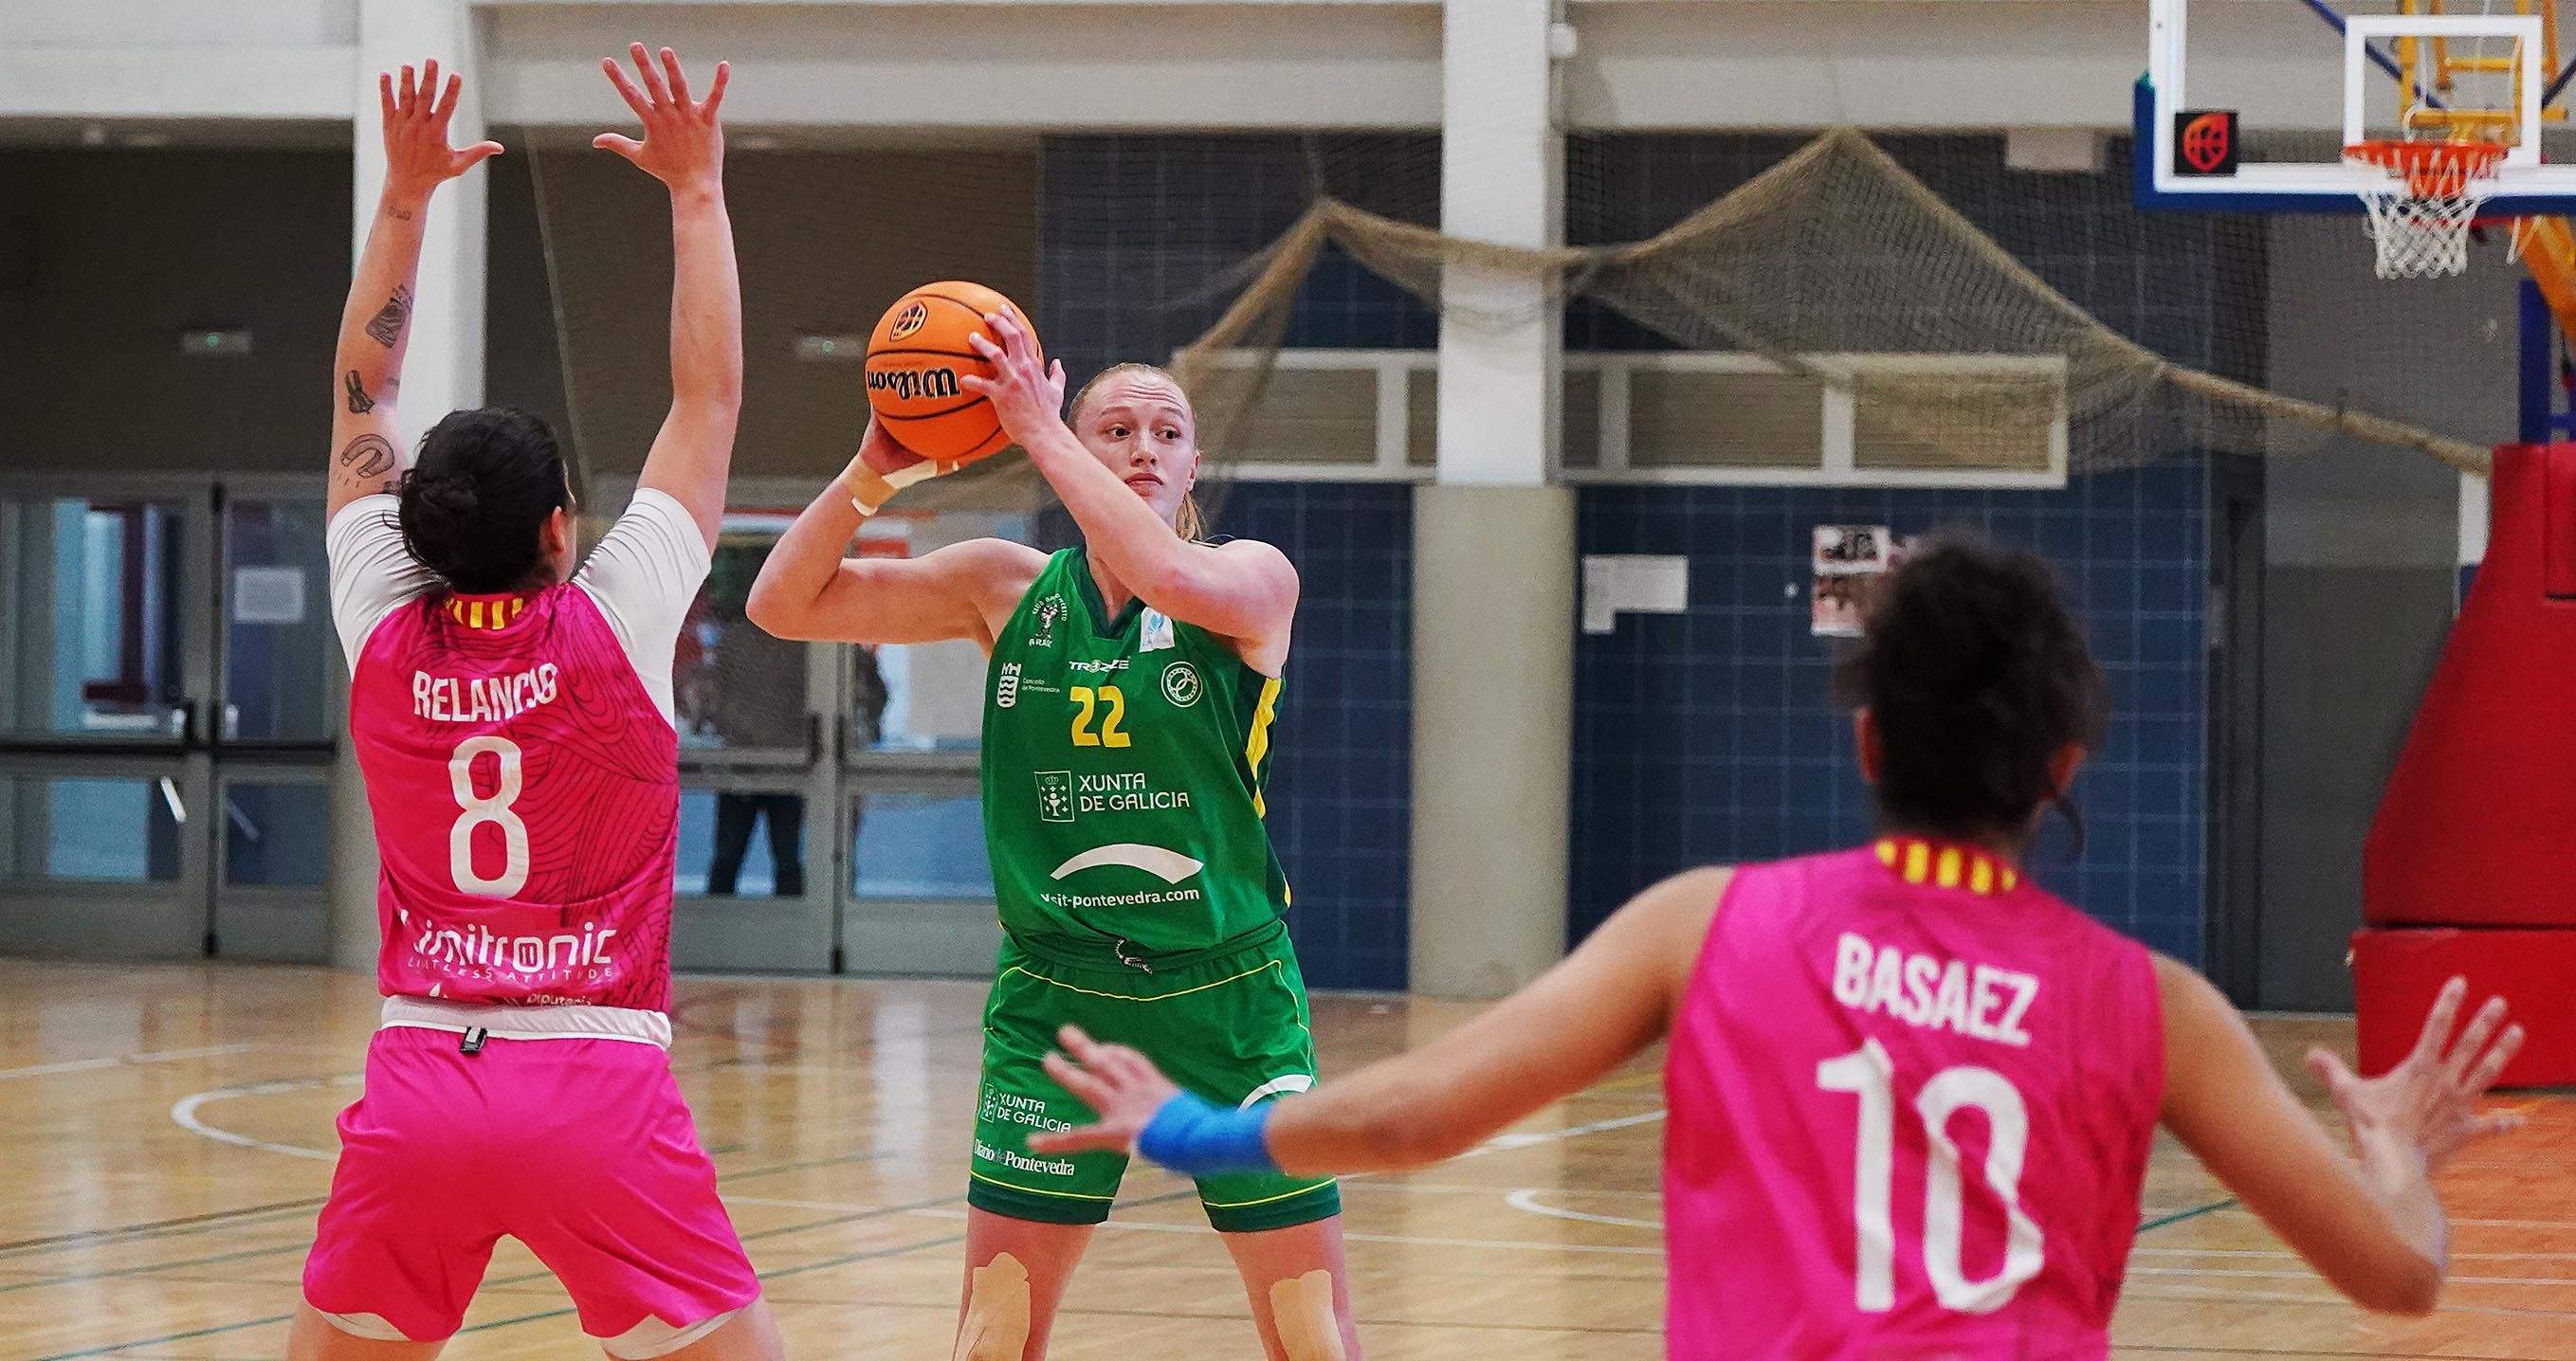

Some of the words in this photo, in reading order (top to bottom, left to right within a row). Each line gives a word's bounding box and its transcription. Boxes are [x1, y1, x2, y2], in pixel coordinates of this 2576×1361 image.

[867, 367, 961, 401] Wilson
[1069, 685, 1131, 748] 22
[1078, 772, 1146, 792] XUNTA
[1080, 795, 1105, 812] DE
[1108, 791, 1190, 811] GALICIA
[448, 735, 529, 900] 8
[1833, 931, 2040, 1047] BASAEZ
[998, 1093, 1046, 1114] XUNTA
[996, 1107, 1012, 1121] DE
[1013, 1111, 1071, 1133] GALICIA
[1005, 1150, 1075, 1176] Pontevedra
[1816, 1037, 2045, 1314] 10
